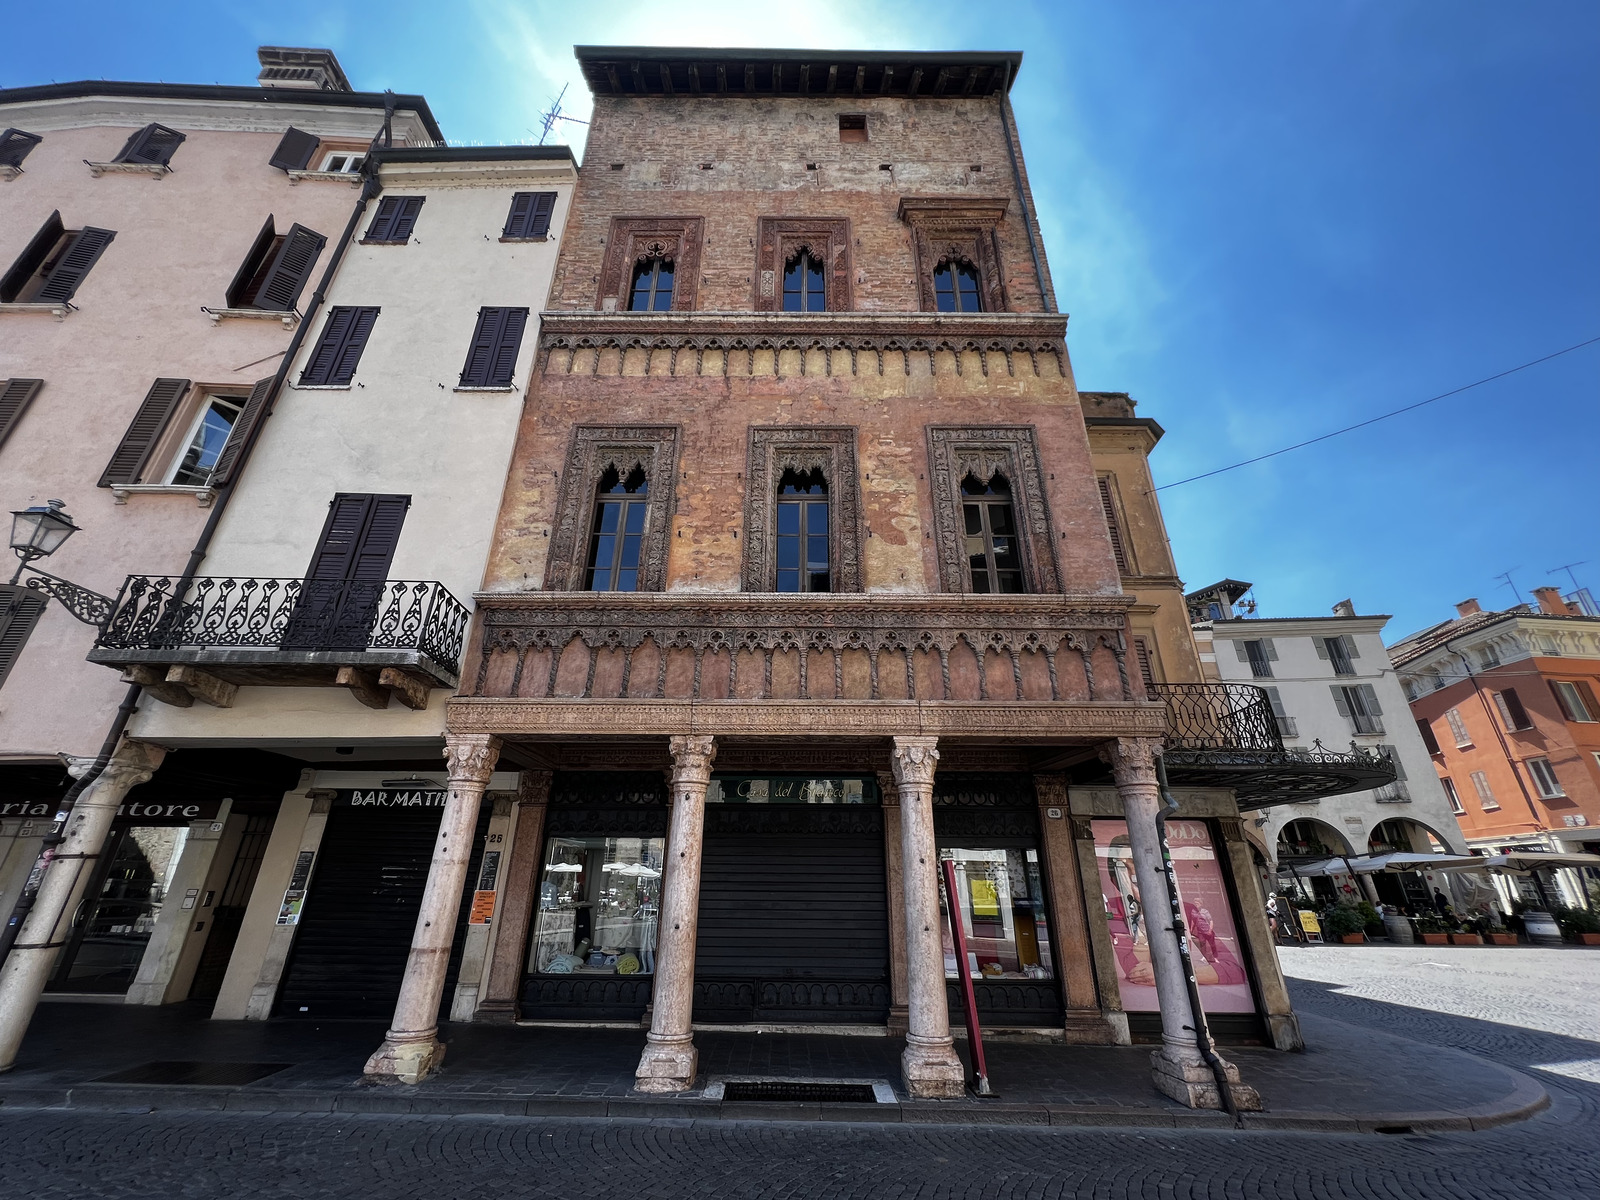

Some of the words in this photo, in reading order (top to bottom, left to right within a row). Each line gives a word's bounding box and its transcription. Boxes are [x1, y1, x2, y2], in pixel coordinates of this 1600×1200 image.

[737, 780, 769, 797] Casa
[774, 781, 794, 797] del
[351, 790, 389, 806] BAR
[489, 833, 503, 844] 25
